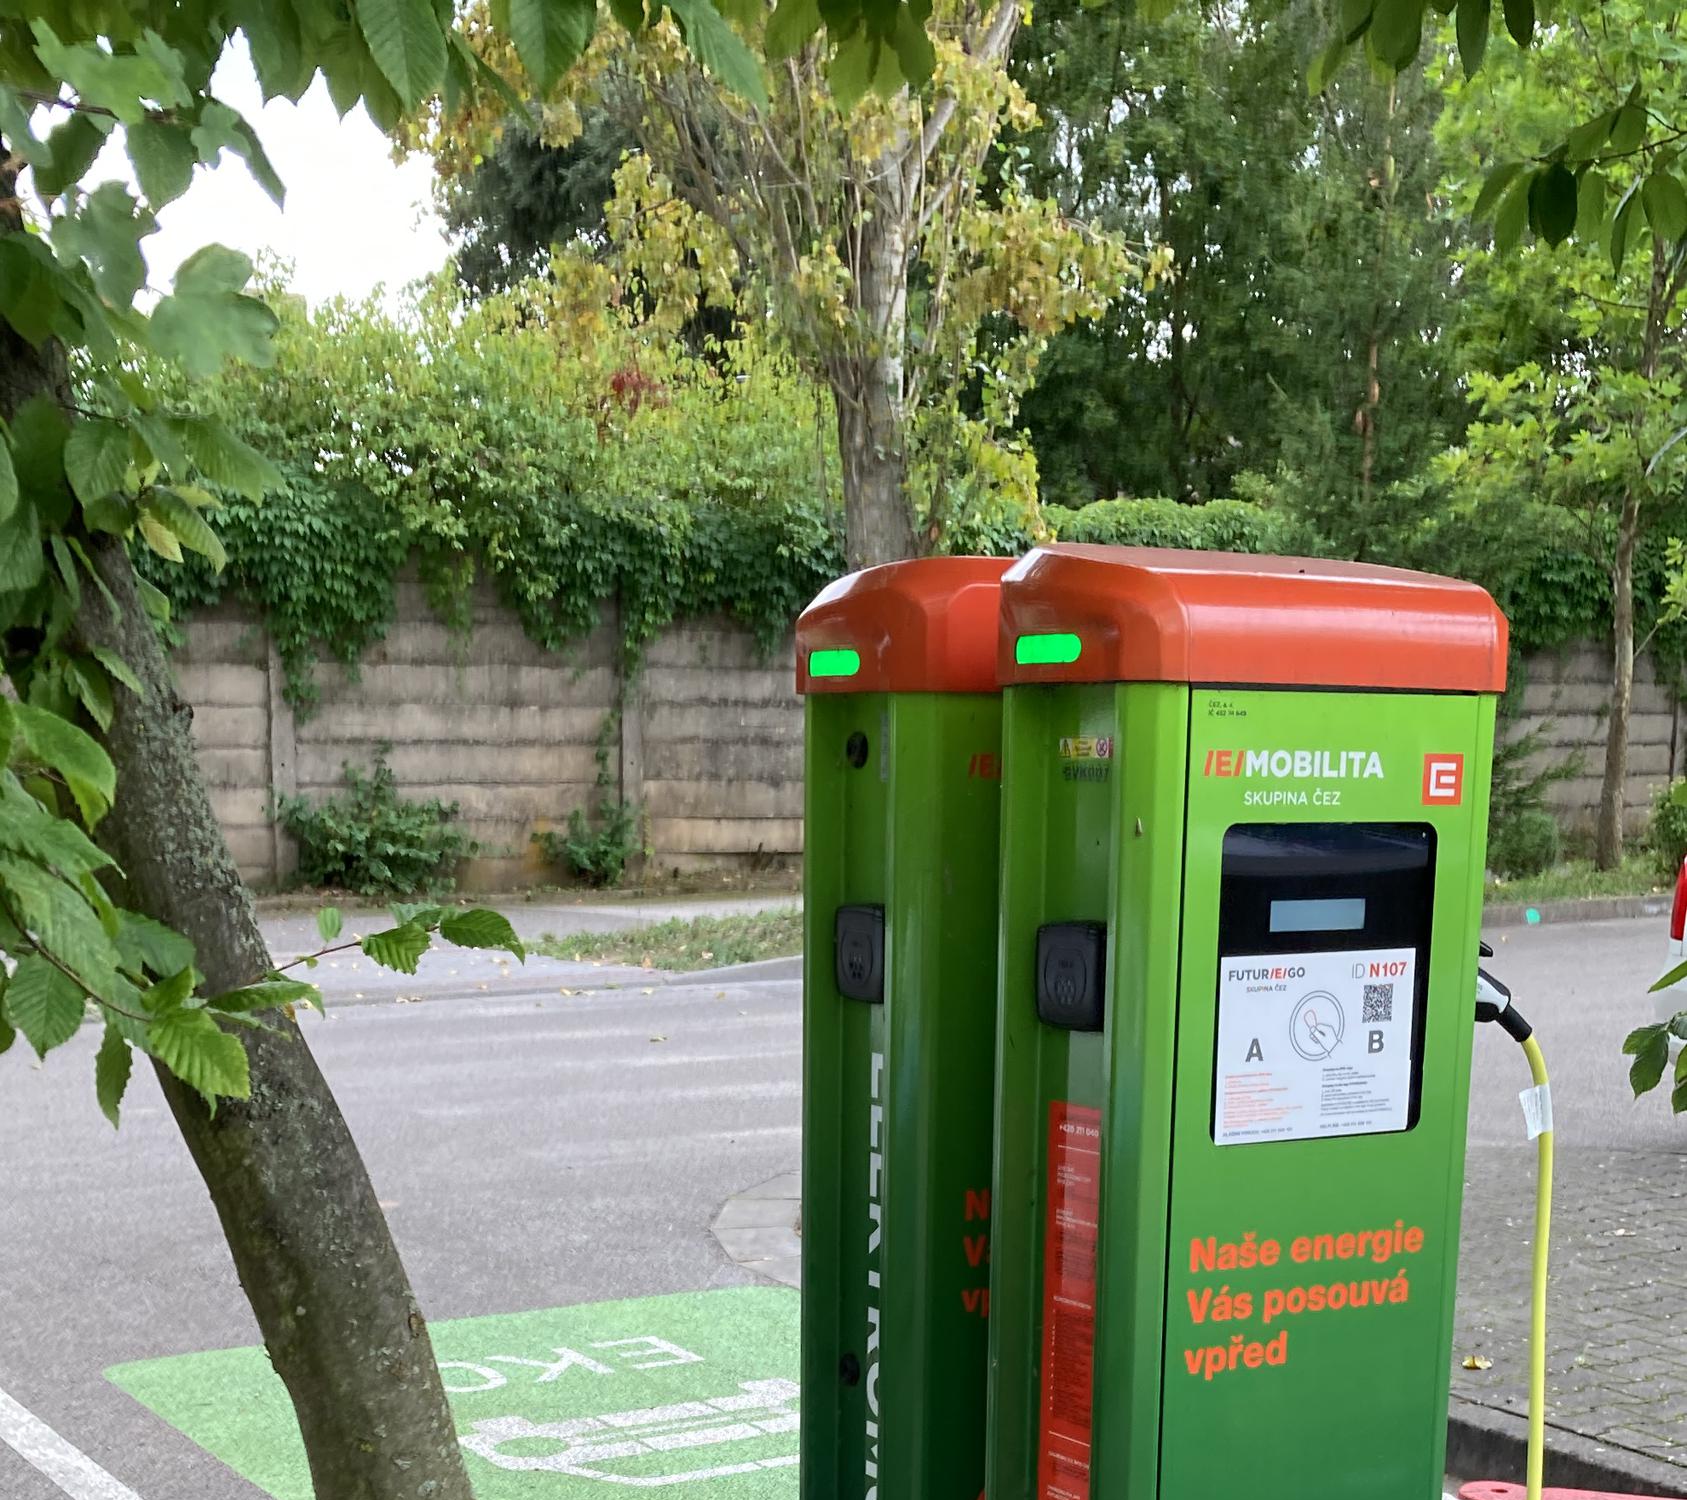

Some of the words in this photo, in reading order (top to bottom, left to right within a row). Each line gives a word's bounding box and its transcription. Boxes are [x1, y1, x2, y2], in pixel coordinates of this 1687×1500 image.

[1244, 791, 1308, 806] SKUPINA
[1313, 788, 1341, 806] ČEZ
[1228, 966, 1306, 981] FUTUR/E/GO
[1352, 963, 1365, 979] ID
[1369, 962, 1407, 978] N107
[1275, 983, 1287, 992] ČEZ
[1245, 1038, 1264, 1063] A
[1367, 1030, 1385, 1054] B
[1189, 1231, 1280, 1273] Naše
[1290, 1219, 1425, 1263] energie
[1187, 1285, 1253, 1324] Vás
[1263, 1268, 1410, 1323] posouvá
[1184, 1331, 1288, 1381] vpřed
